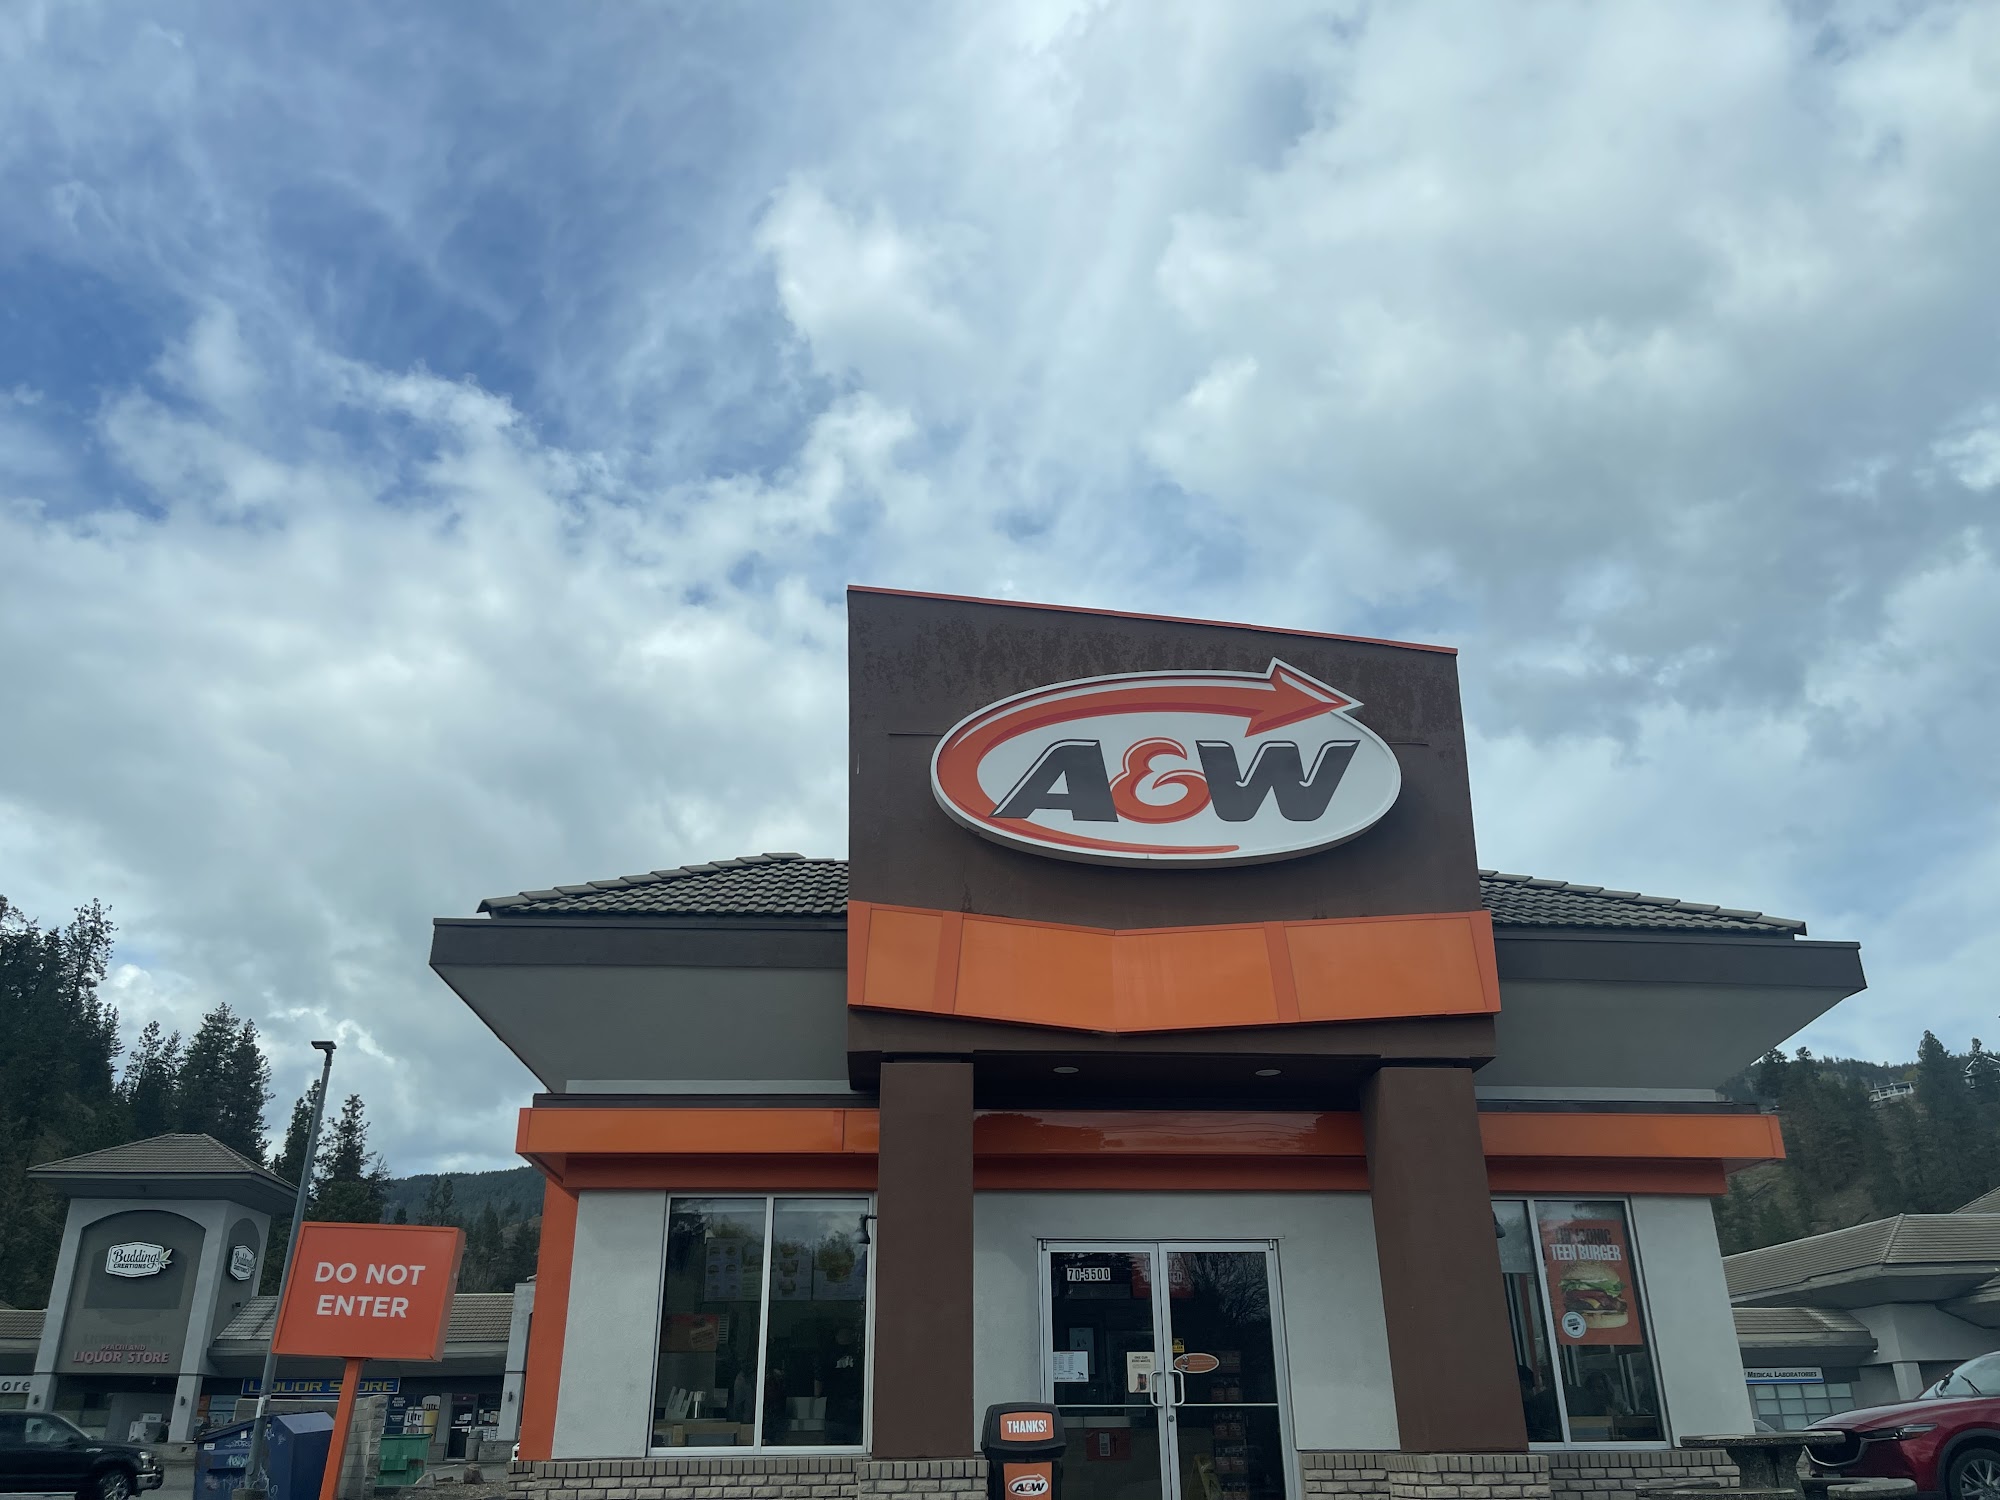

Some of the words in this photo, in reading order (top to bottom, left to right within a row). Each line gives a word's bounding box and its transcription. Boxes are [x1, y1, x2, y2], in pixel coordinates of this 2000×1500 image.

[988, 737, 1361, 824] A&W
[112, 1248, 159, 1269] Budding
[1549, 1244, 1577, 1261] TEEN
[1577, 1244, 1622, 1261] BURGER
[314, 1261, 357, 1284] DO
[365, 1263, 426, 1286] NOT
[316, 1294, 409, 1318] ENTER
[100, 1343, 146, 1351] PEACHLAND
[73, 1351, 122, 1365] LIQUOR
[127, 1351, 170, 1364] STORE
[248, 1380, 323, 1393] LQUOR
[328, 1380, 395, 1393] SORE
[1006, 1419, 1047, 1433] THANKS!
[1014, 1482, 1046, 1492] A&W
